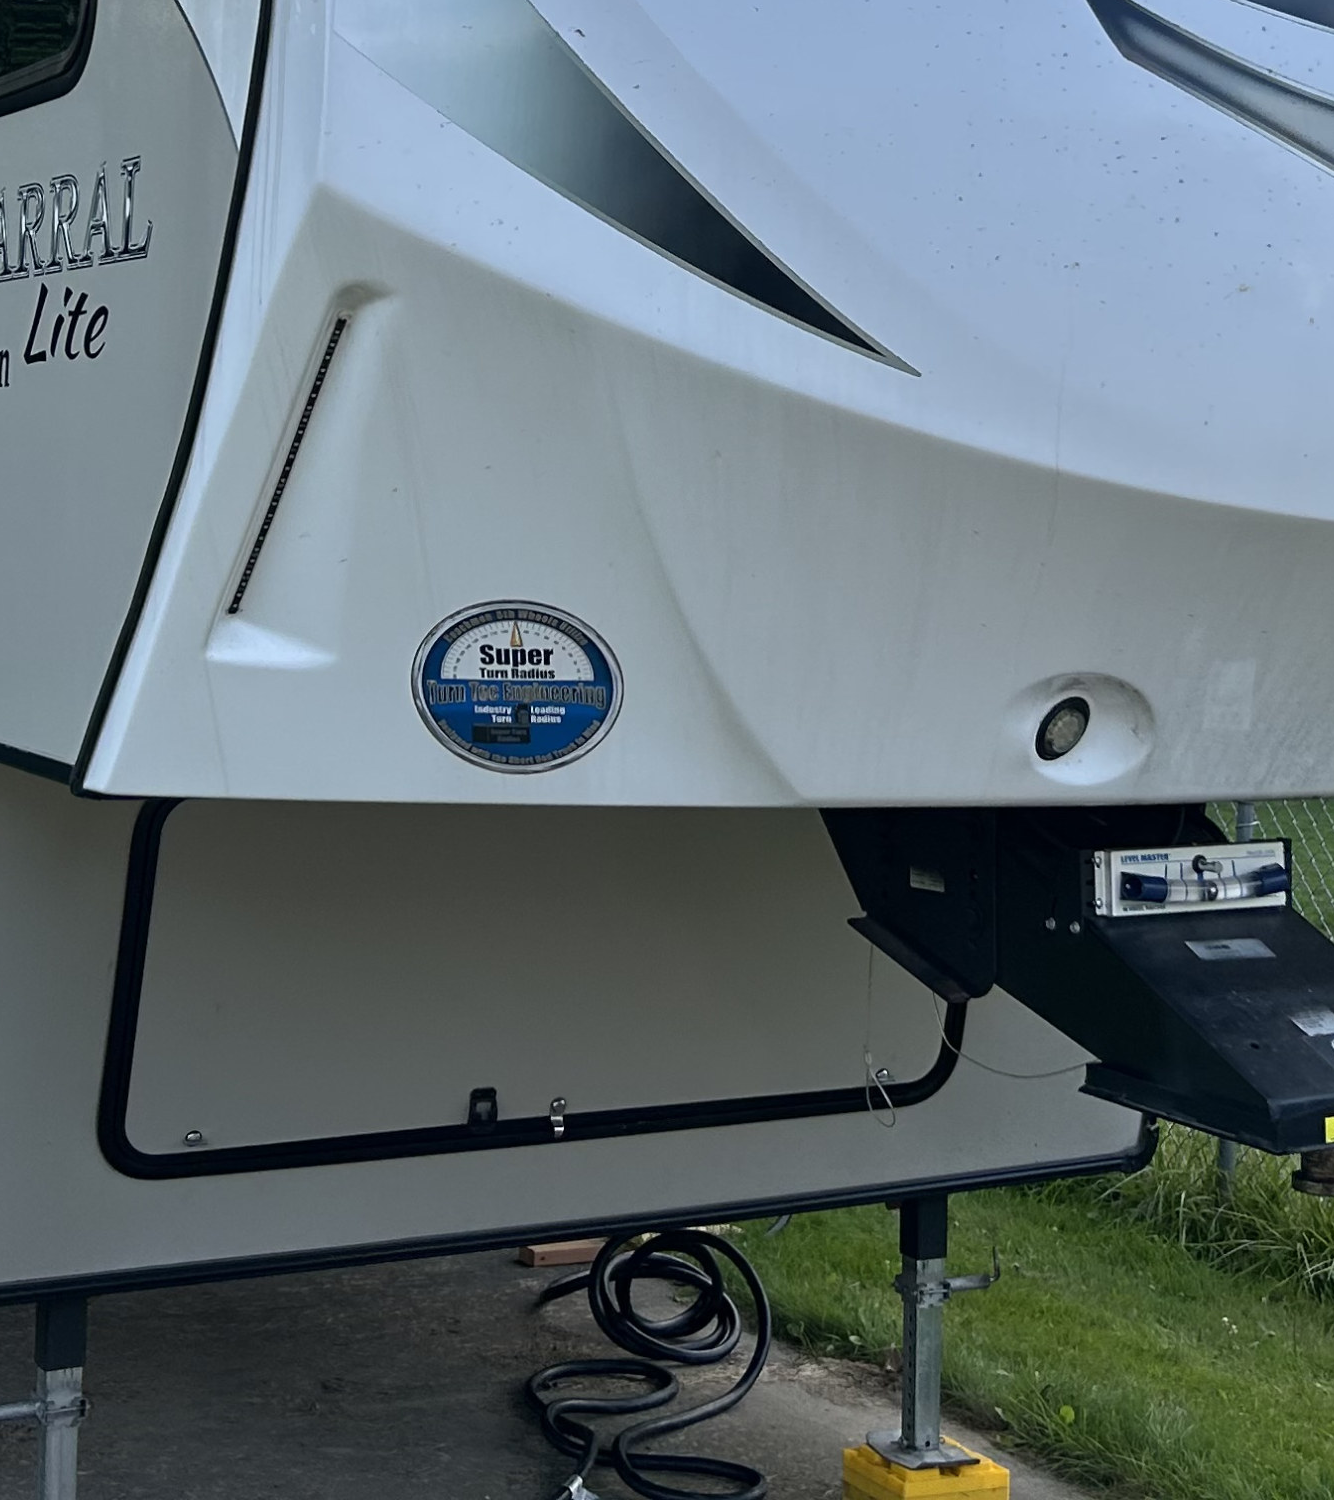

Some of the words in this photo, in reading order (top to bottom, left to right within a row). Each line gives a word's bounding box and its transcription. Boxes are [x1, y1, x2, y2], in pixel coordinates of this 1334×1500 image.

[23, 283, 109, 365] Lite
[479, 644, 554, 667] Super
[479, 668, 508, 679] Turn
[511, 667, 555, 679] Radius
[427, 679, 466, 705] Turn
[503, 682, 607, 709] Engineering
[474, 705, 512, 715] Industry
[530, 705, 565, 716] Leading
[492, 714, 512, 724] Turn
[530, 715, 562, 724] Radius
[1120, 855, 1140, 865] LEVEL
[1140, 853, 1169, 862] MASTER
